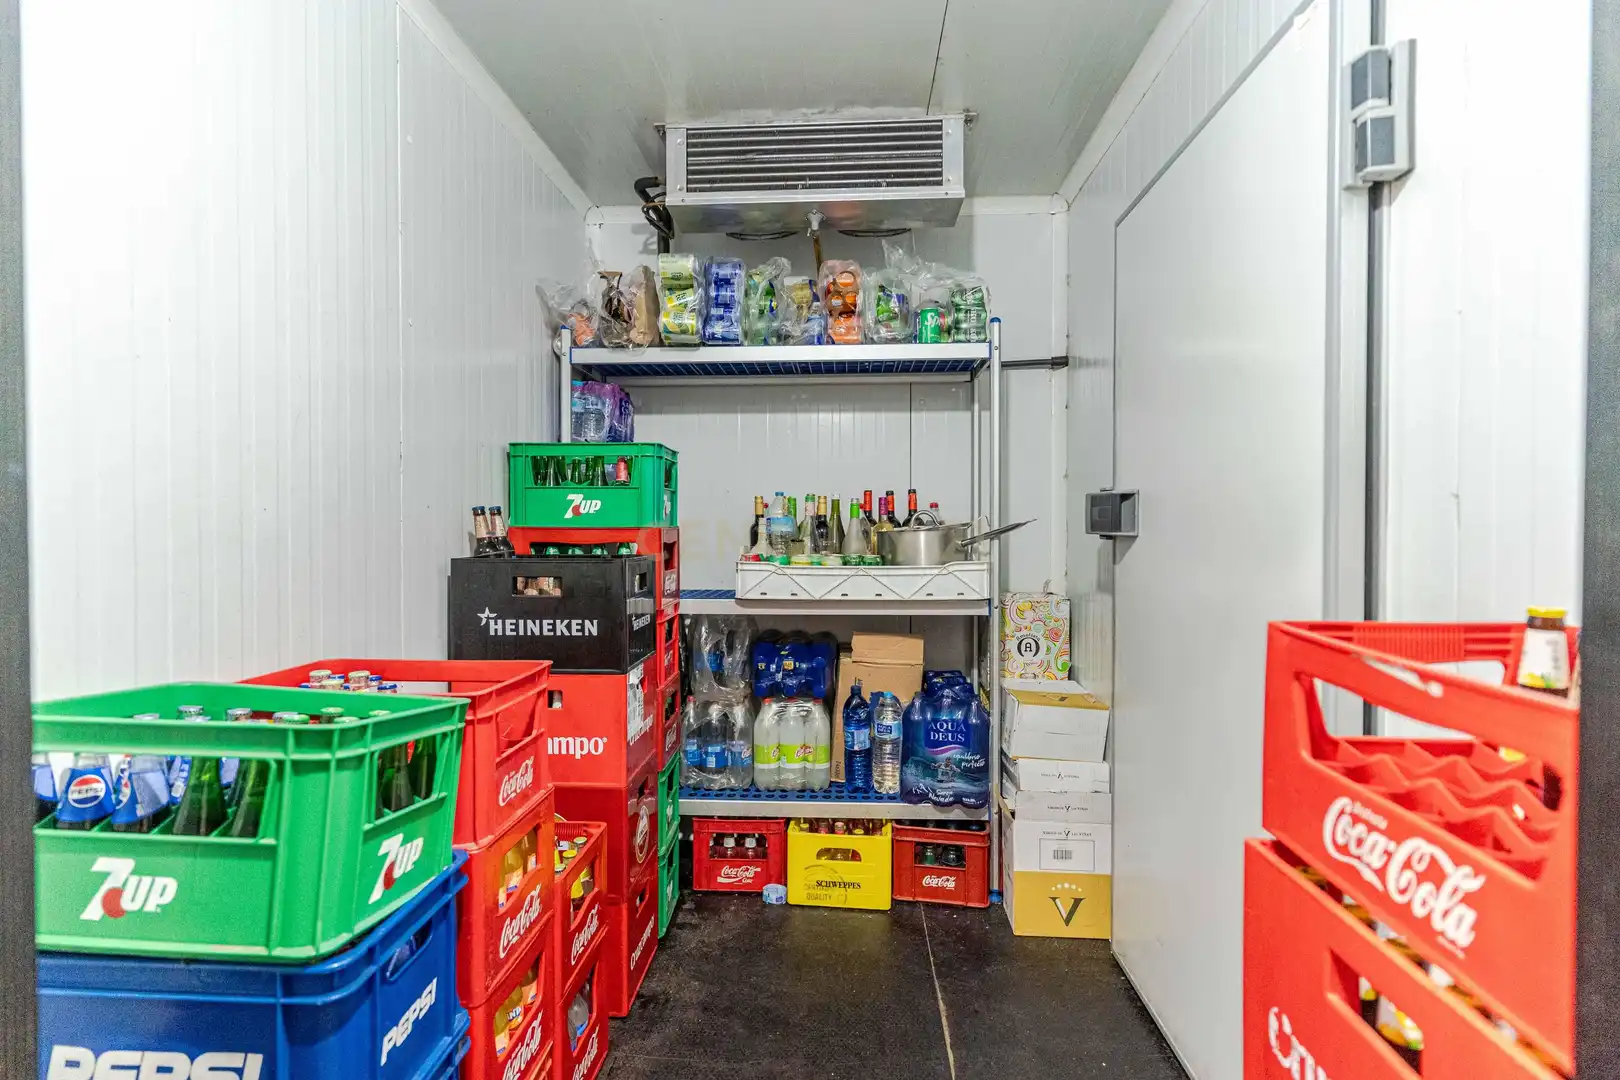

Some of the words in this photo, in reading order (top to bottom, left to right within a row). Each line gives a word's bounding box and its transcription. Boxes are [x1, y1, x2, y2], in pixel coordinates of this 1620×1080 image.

[564, 494, 601, 518] 7UP
[489, 619, 598, 636] HEINEKEN
[928, 719, 967, 732] AQUA
[930, 731, 965, 742] DEUS
[499, 756, 534, 806] Coca-Cola
[368, 833, 424, 904] 7UP
[721, 865, 760, 878] Coca-Cola
[815, 879, 861, 890] SCHWEPPES
[922, 875, 957, 889] Coca-Cola
[1323, 796, 1487, 948] Coca-Cola
[80, 857, 178, 921] 7UP
[500, 884, 541, 959] Coca-Cola
[1048, 896, 1086, 927] V
[571, 904, 600, 965] Coca-Cola
[380, 977, 437, 1066] PEPSI
[47, 1045, 263, 1080] PEPSI
